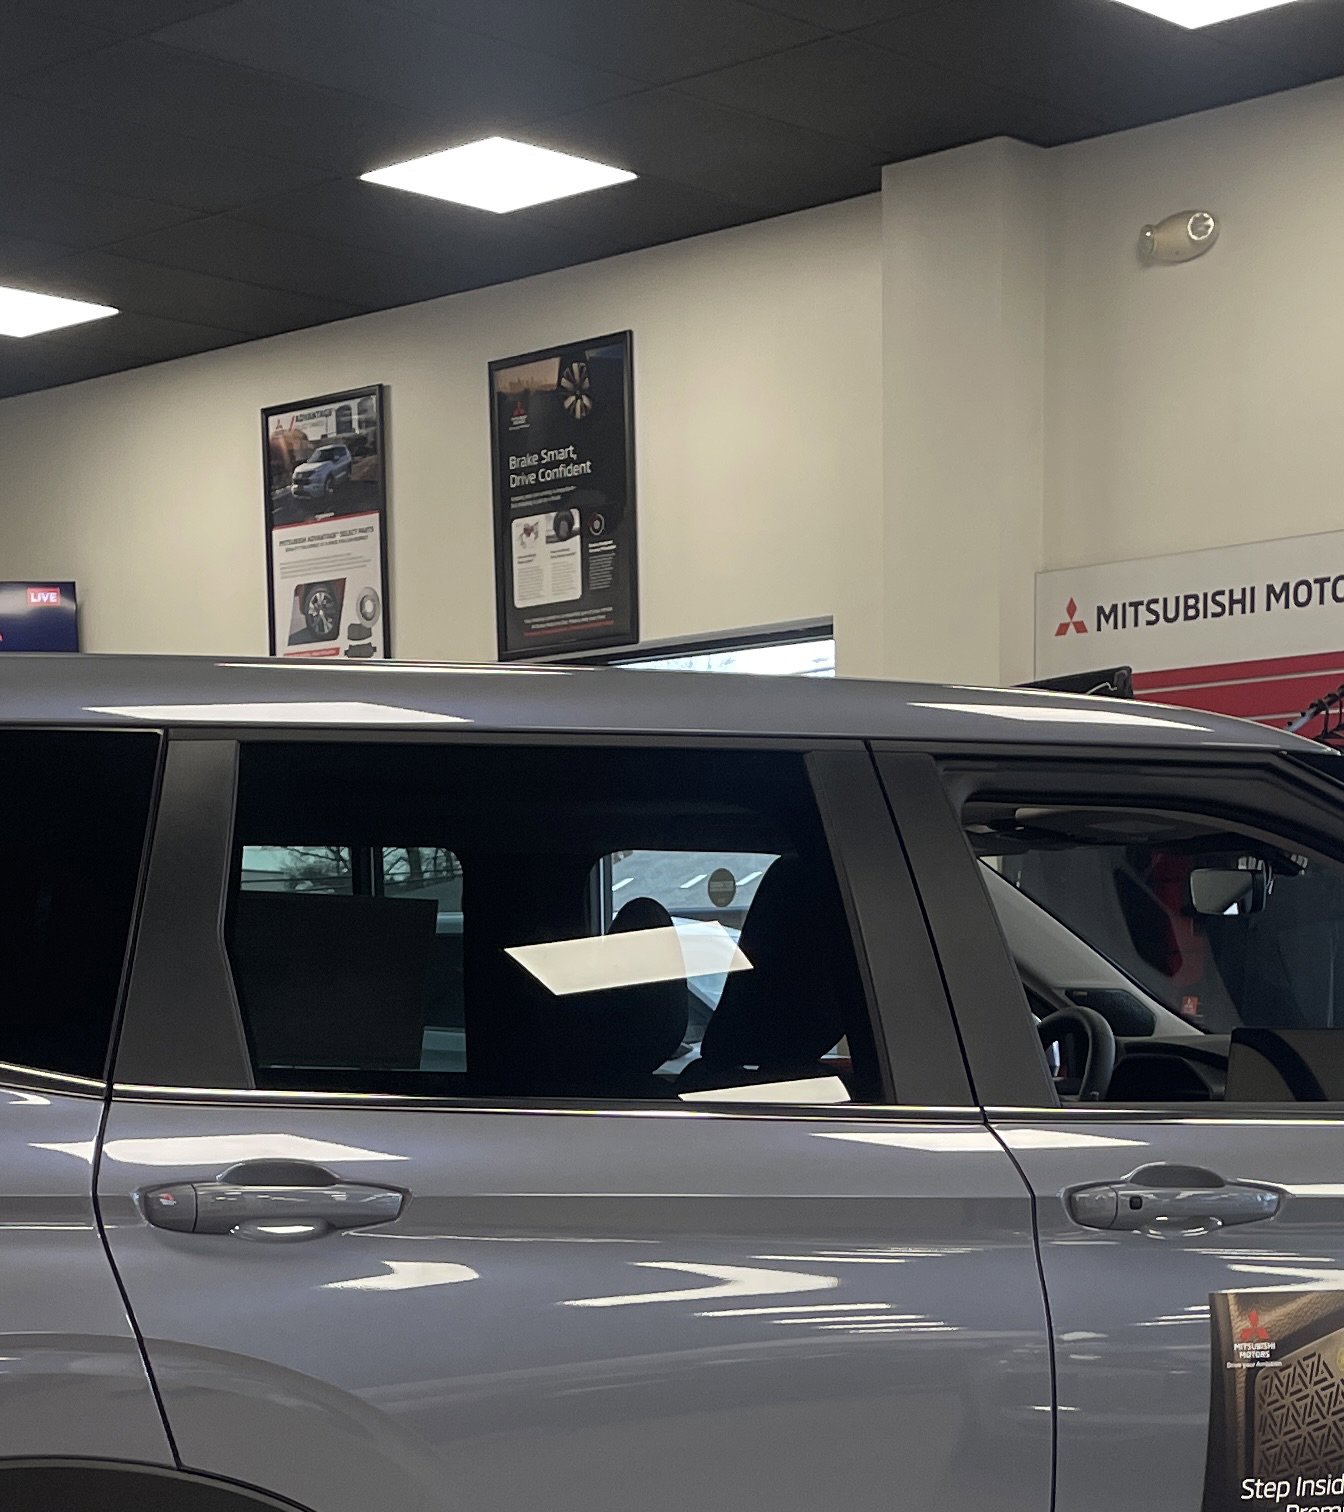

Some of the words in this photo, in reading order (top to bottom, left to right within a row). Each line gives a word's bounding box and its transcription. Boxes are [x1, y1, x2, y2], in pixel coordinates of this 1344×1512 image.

[509, 453, 538, 469] Brake
[540, 445, 577, 463] Smart,
[509, 472, 536, 488] Drive
[538, 461, 592, 482] Confident
[30, 592, 57, 603] LIVE
[1096, 586, 1255, 631] MITSUBISHI
[1233, 1342, 1276, 1351] MITSUBISHI
[1239, 1351, 1271, 1359] MOTORS
[1240, 1478, 1290, 1503] Step
